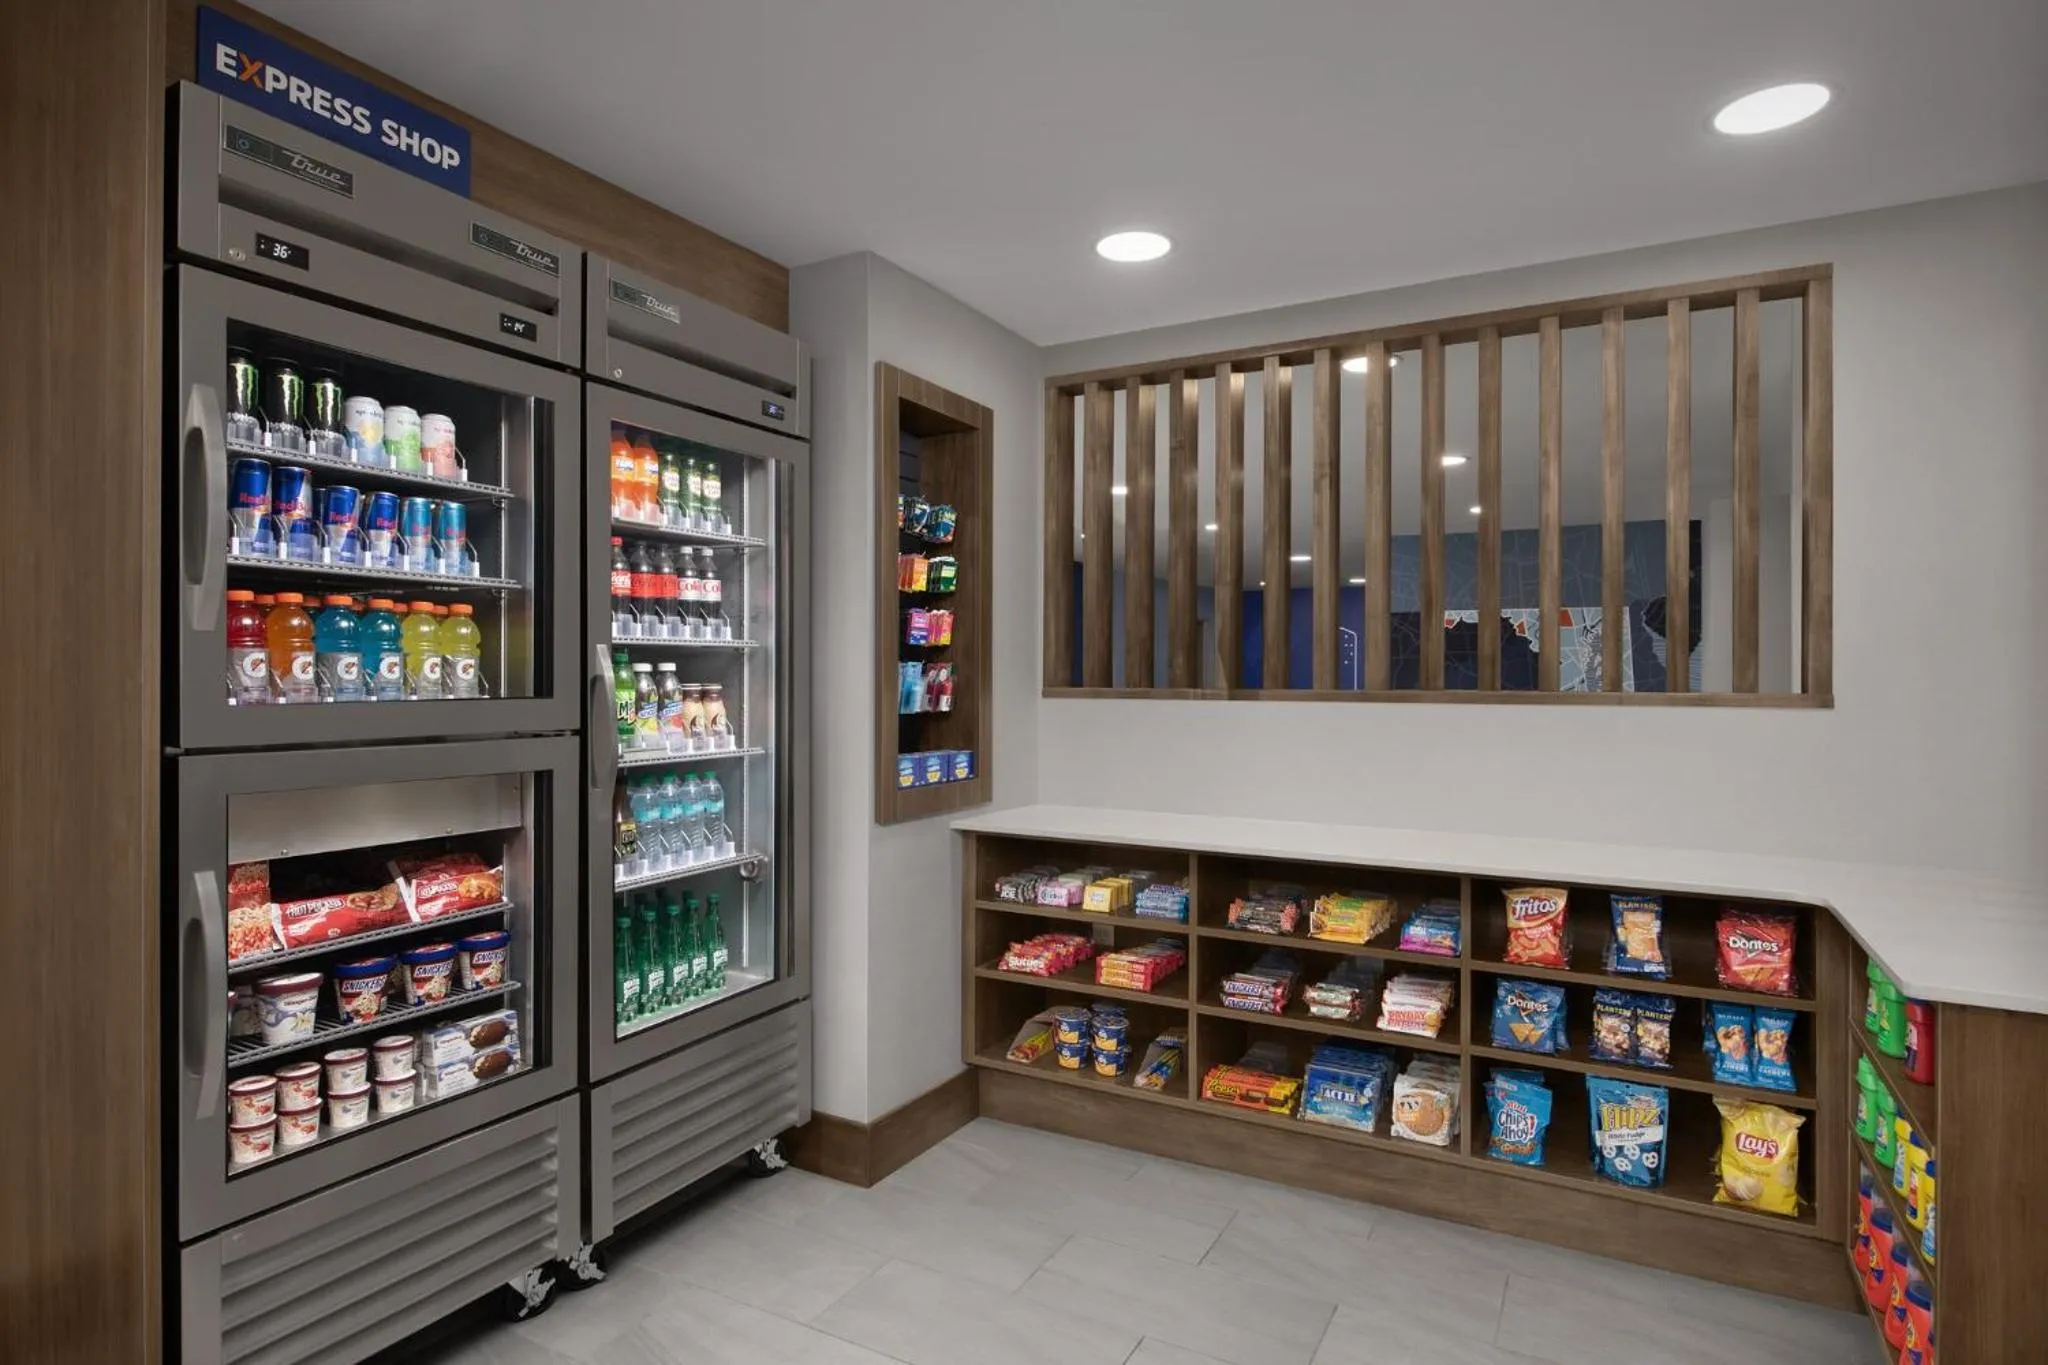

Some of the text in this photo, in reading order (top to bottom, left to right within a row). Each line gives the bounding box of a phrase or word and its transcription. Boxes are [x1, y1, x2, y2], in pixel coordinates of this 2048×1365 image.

[215, 43, 461, 171] EXPRESS SHOP
[1728, 936, 1778, 952] Doritos
[1508, 995, 1549, 1013] Doritos
